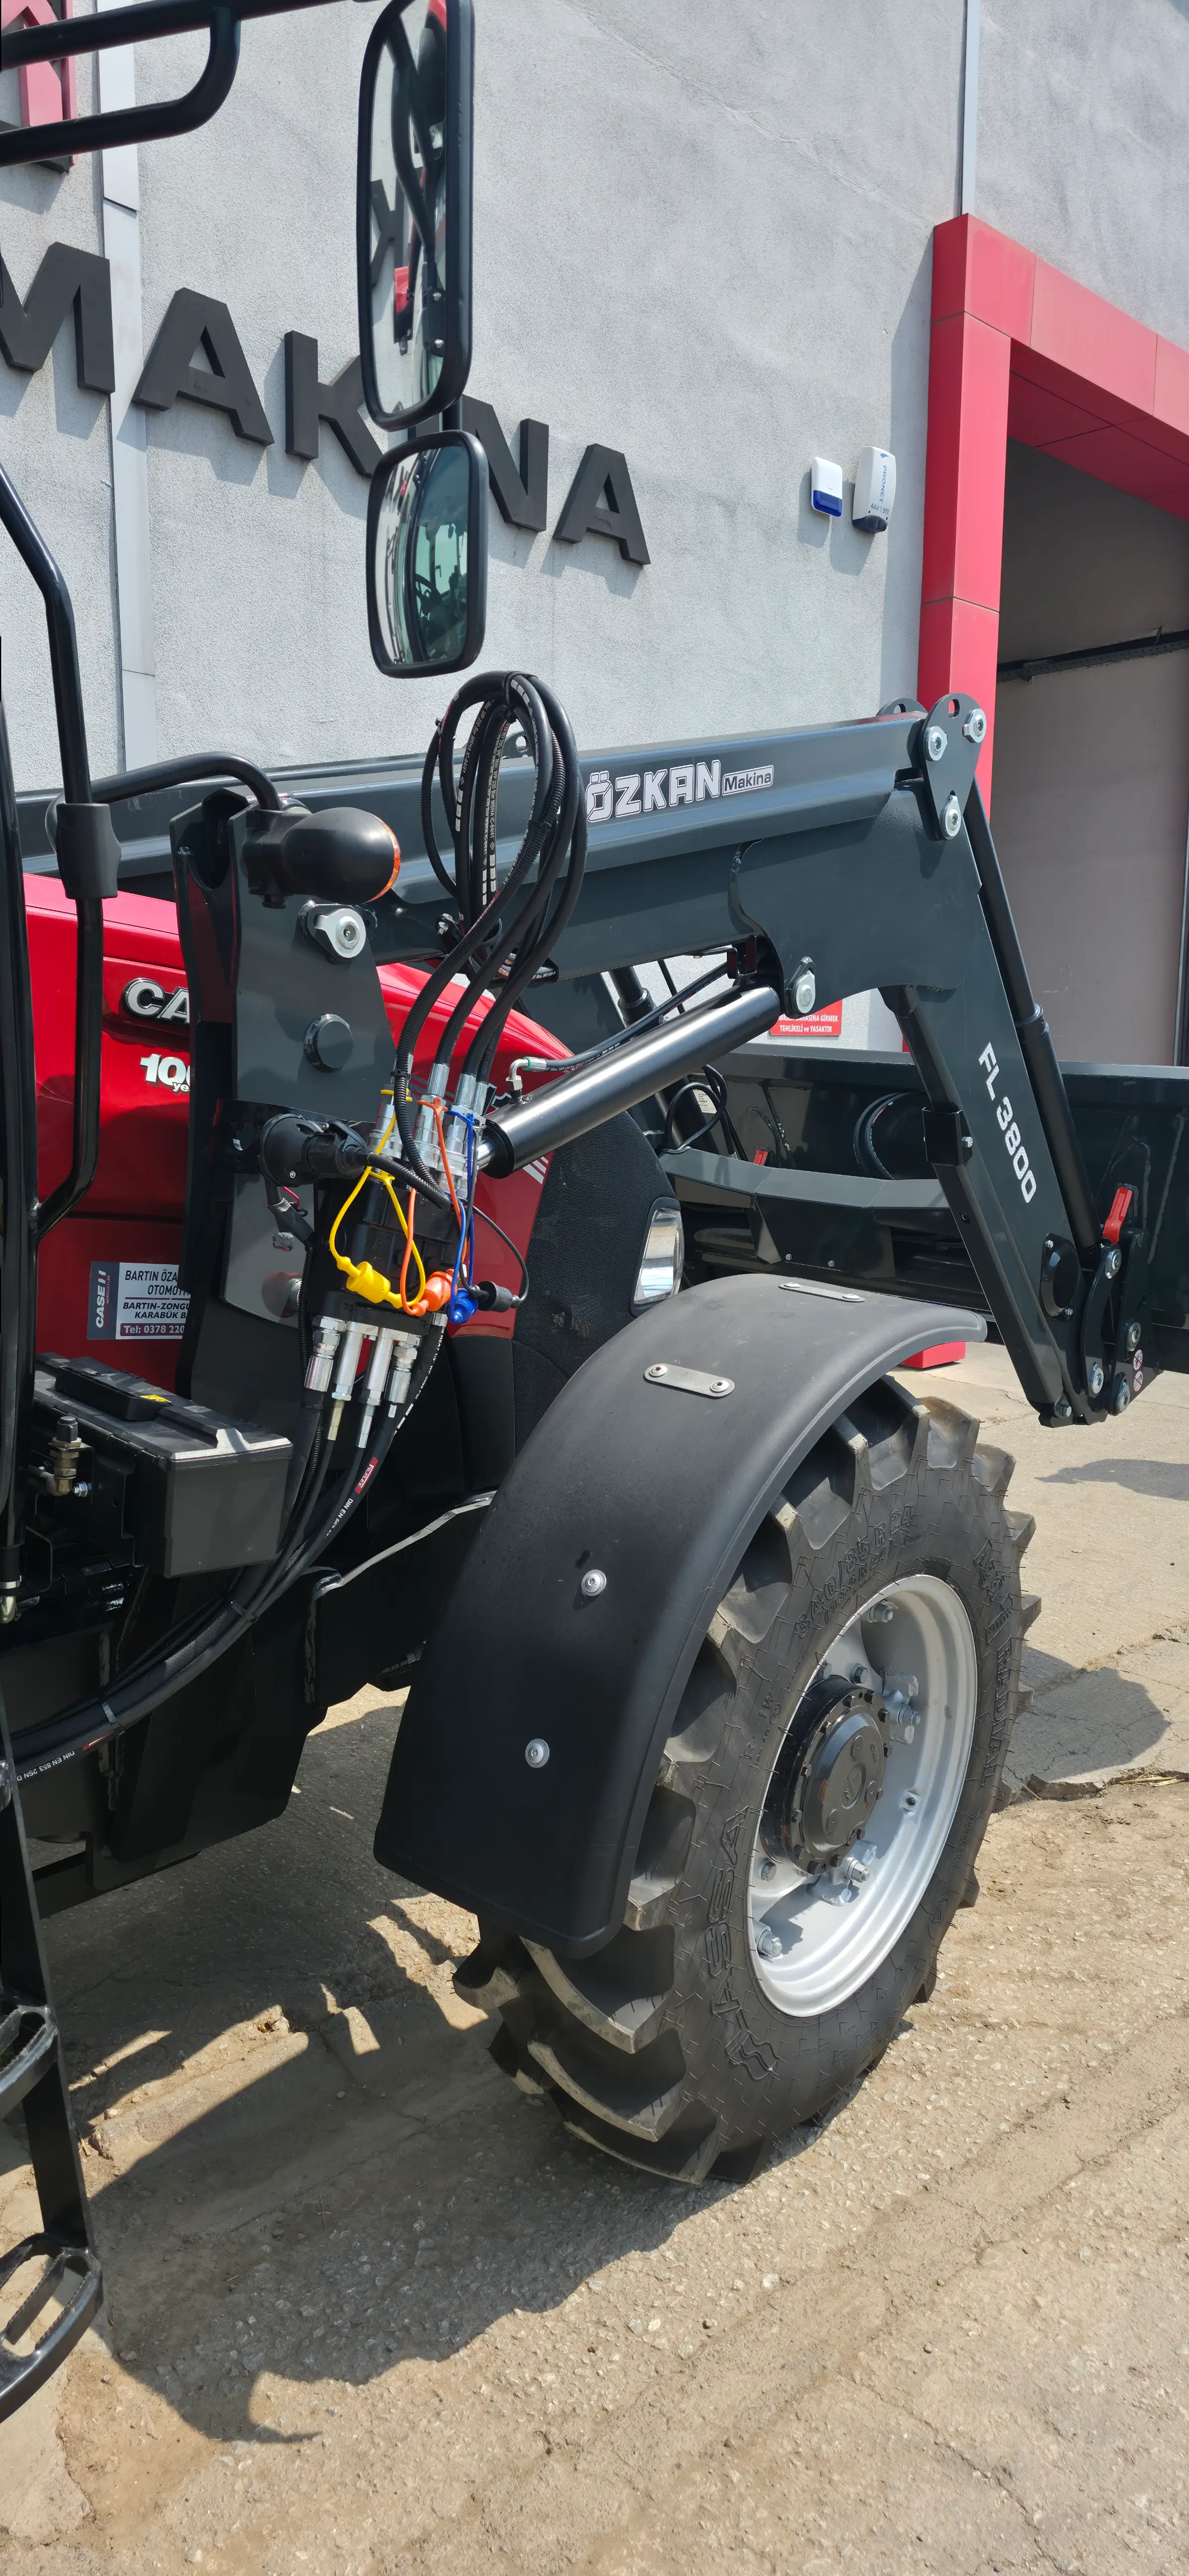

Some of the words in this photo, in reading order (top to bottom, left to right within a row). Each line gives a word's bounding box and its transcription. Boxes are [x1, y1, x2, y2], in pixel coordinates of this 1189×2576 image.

[0, 242, 650, 566] MAKNA
[478, 709, 487, 719] WP
[475, 716, 484, 727] 330
[471, 725, 479, 736] Bar
[466, 734, 476, 751] MSHA
[492, 770, 498, 779] WP
[586, 759, 721, 823] ÖZKAN
[724, 772, 771, 792] Makina
[124, 977, 190, 1024] CA
[140, 1053, 190, 1086] 10
[978, 1041, 999, 1101] FL
[996, 1095, 1036, 1204] 3800
[125, 1270, 159, 1281] BARTIN
[96, 1285, 106, 1328] CASE
[123, 1325, 141, 1334] Tel:
[343, 1497, 354, 1509] DIN
[336, 1508, 346, 1518] EN
[61, 1749, 75, 1761] DIN
[38, 1762, 52, 1771] 853
[51, 1756, 62, 1766] EN
[22, 1768, 38, 1778] 2SN
